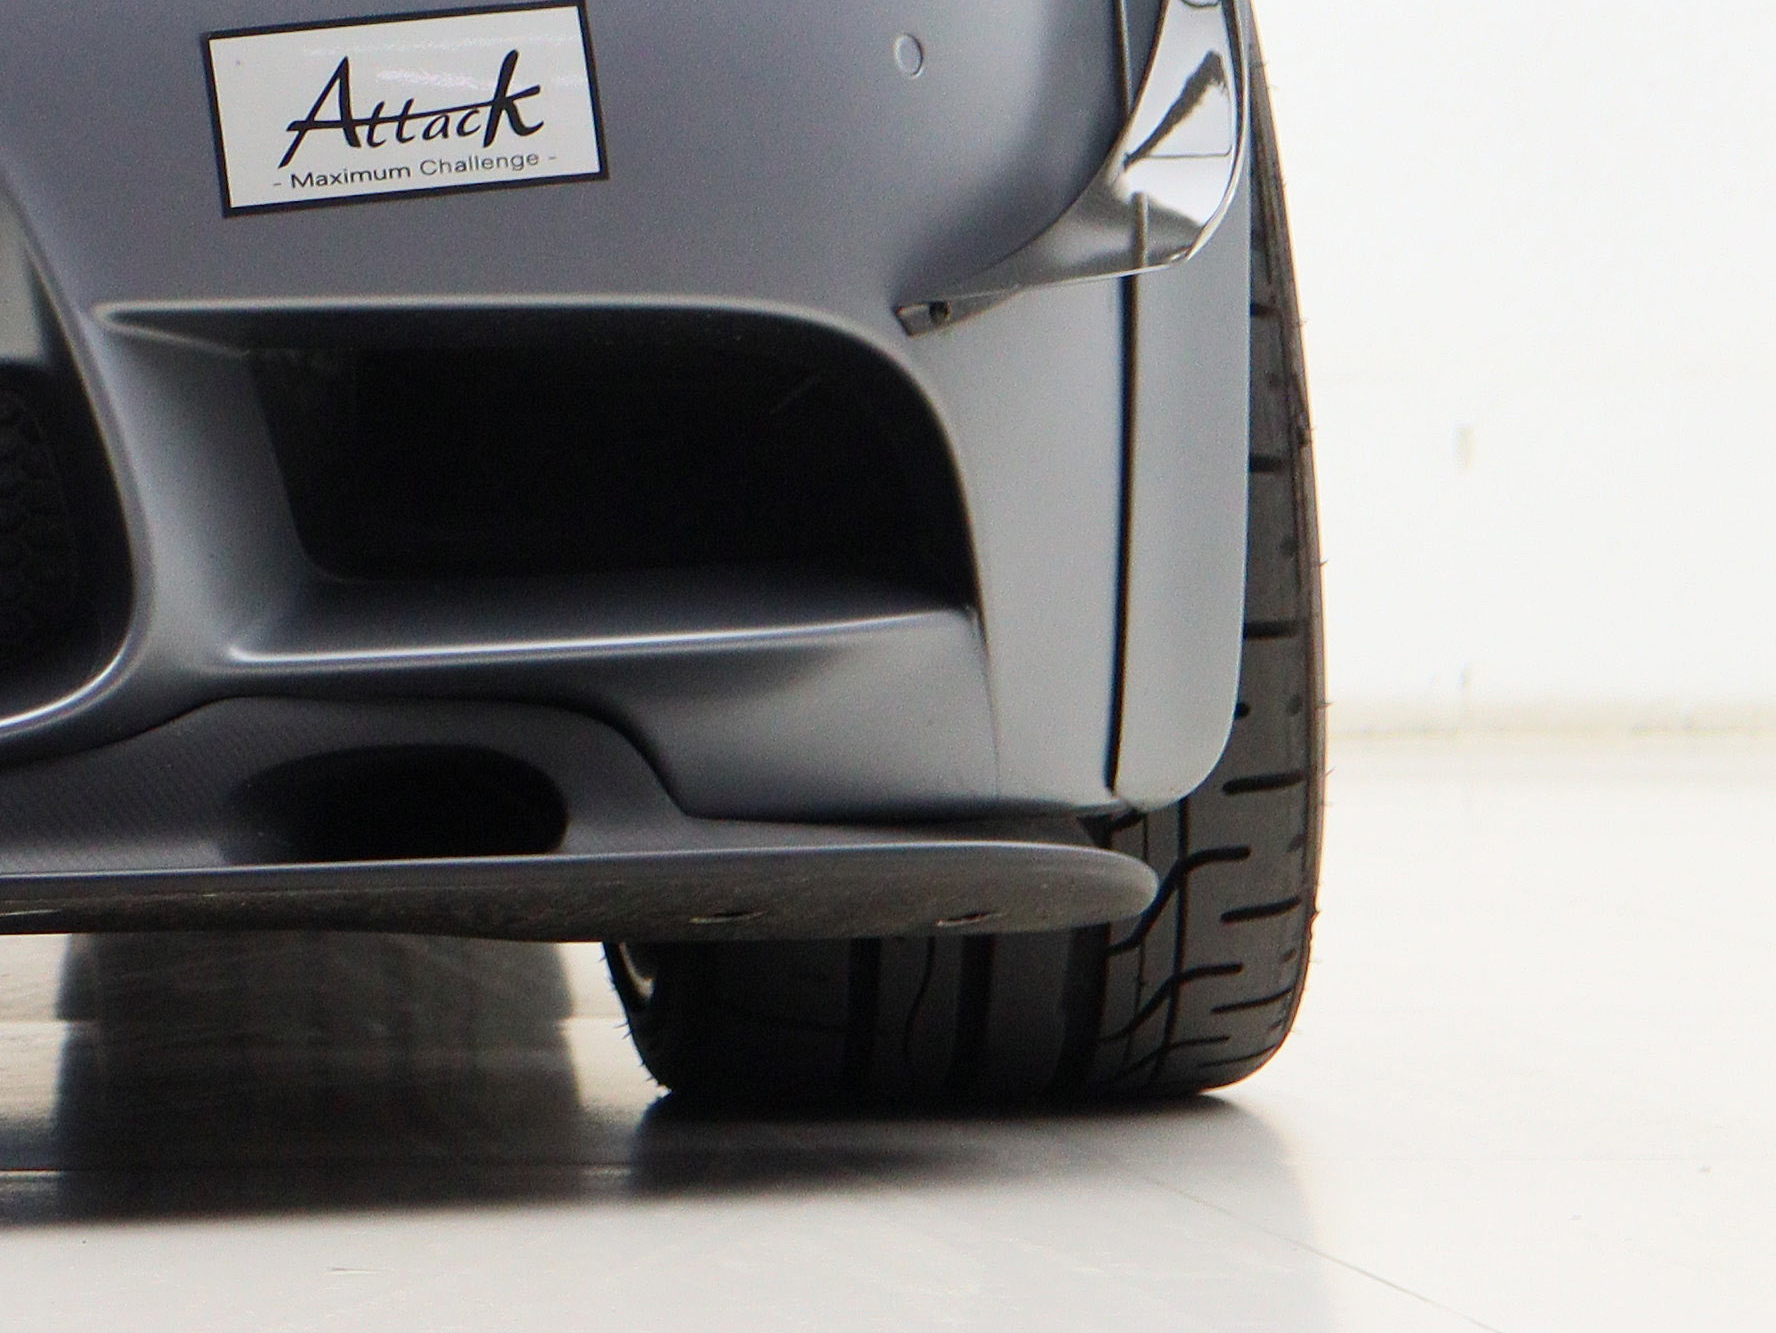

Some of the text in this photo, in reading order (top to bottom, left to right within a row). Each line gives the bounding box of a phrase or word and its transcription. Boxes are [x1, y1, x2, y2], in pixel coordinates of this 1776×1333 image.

[277, 49, 544, 169] Attack
[290, 151, 540, 189] Maximum Challenge
